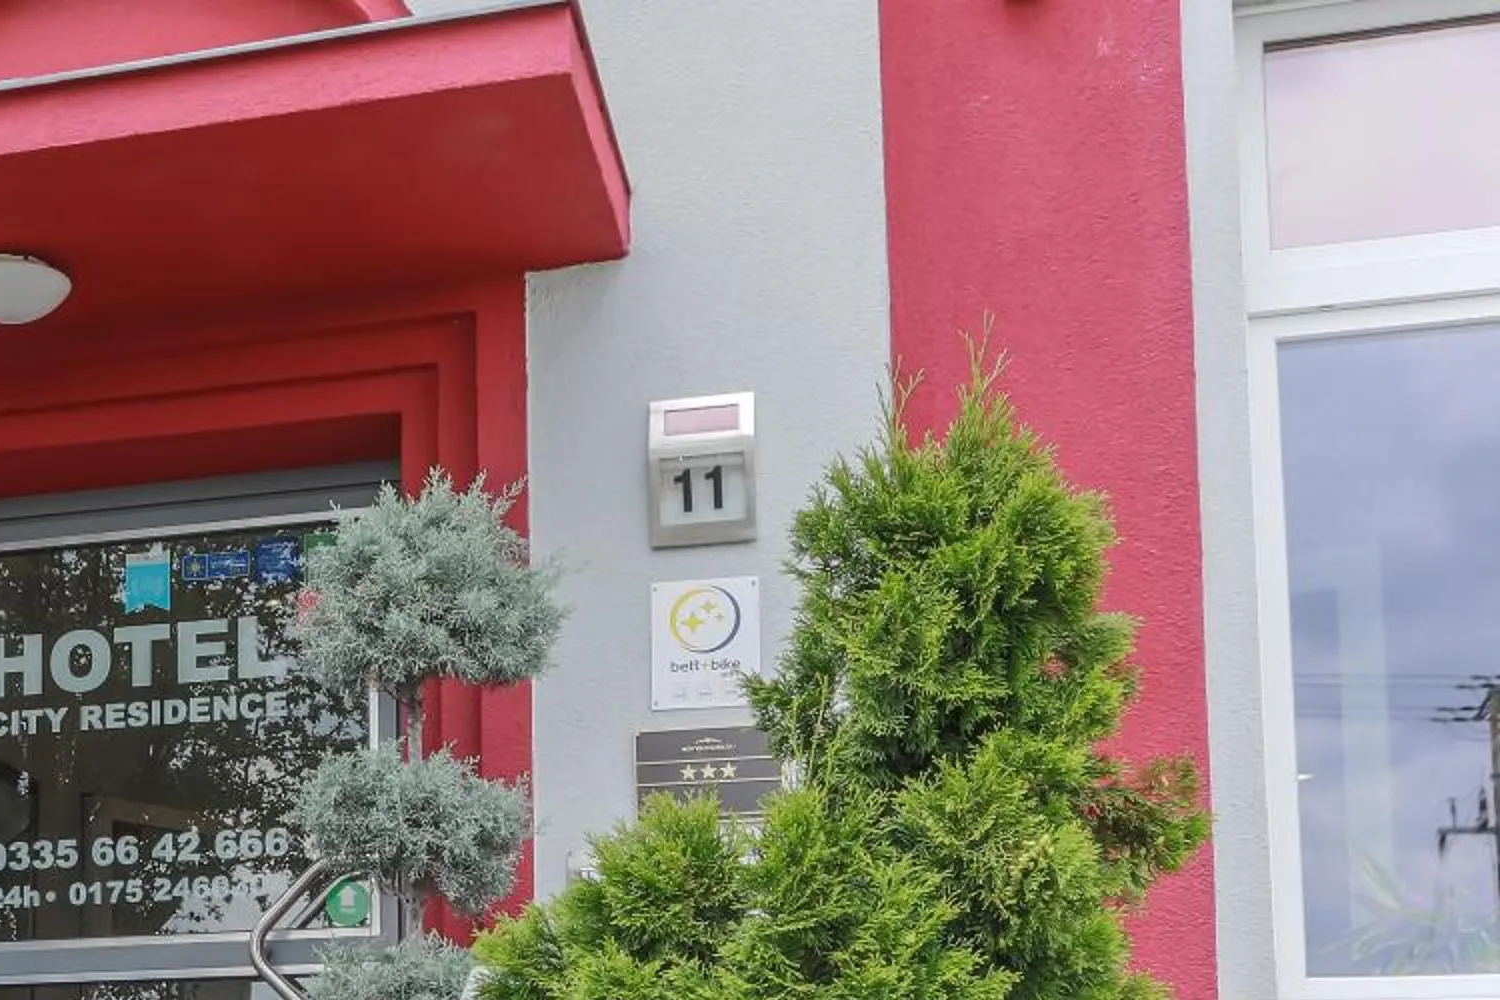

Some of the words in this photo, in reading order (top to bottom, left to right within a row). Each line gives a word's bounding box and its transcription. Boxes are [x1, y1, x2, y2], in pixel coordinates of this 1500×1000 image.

[673, 464, 724, 513] 11
[79, 691, 288, 731] RESIDENCE
[90, 835, 140, 867] 66
[152, 831, 201, 863] 42
[213, 827, 290, 860] 666
[68, 879, 143, 906] 0175
